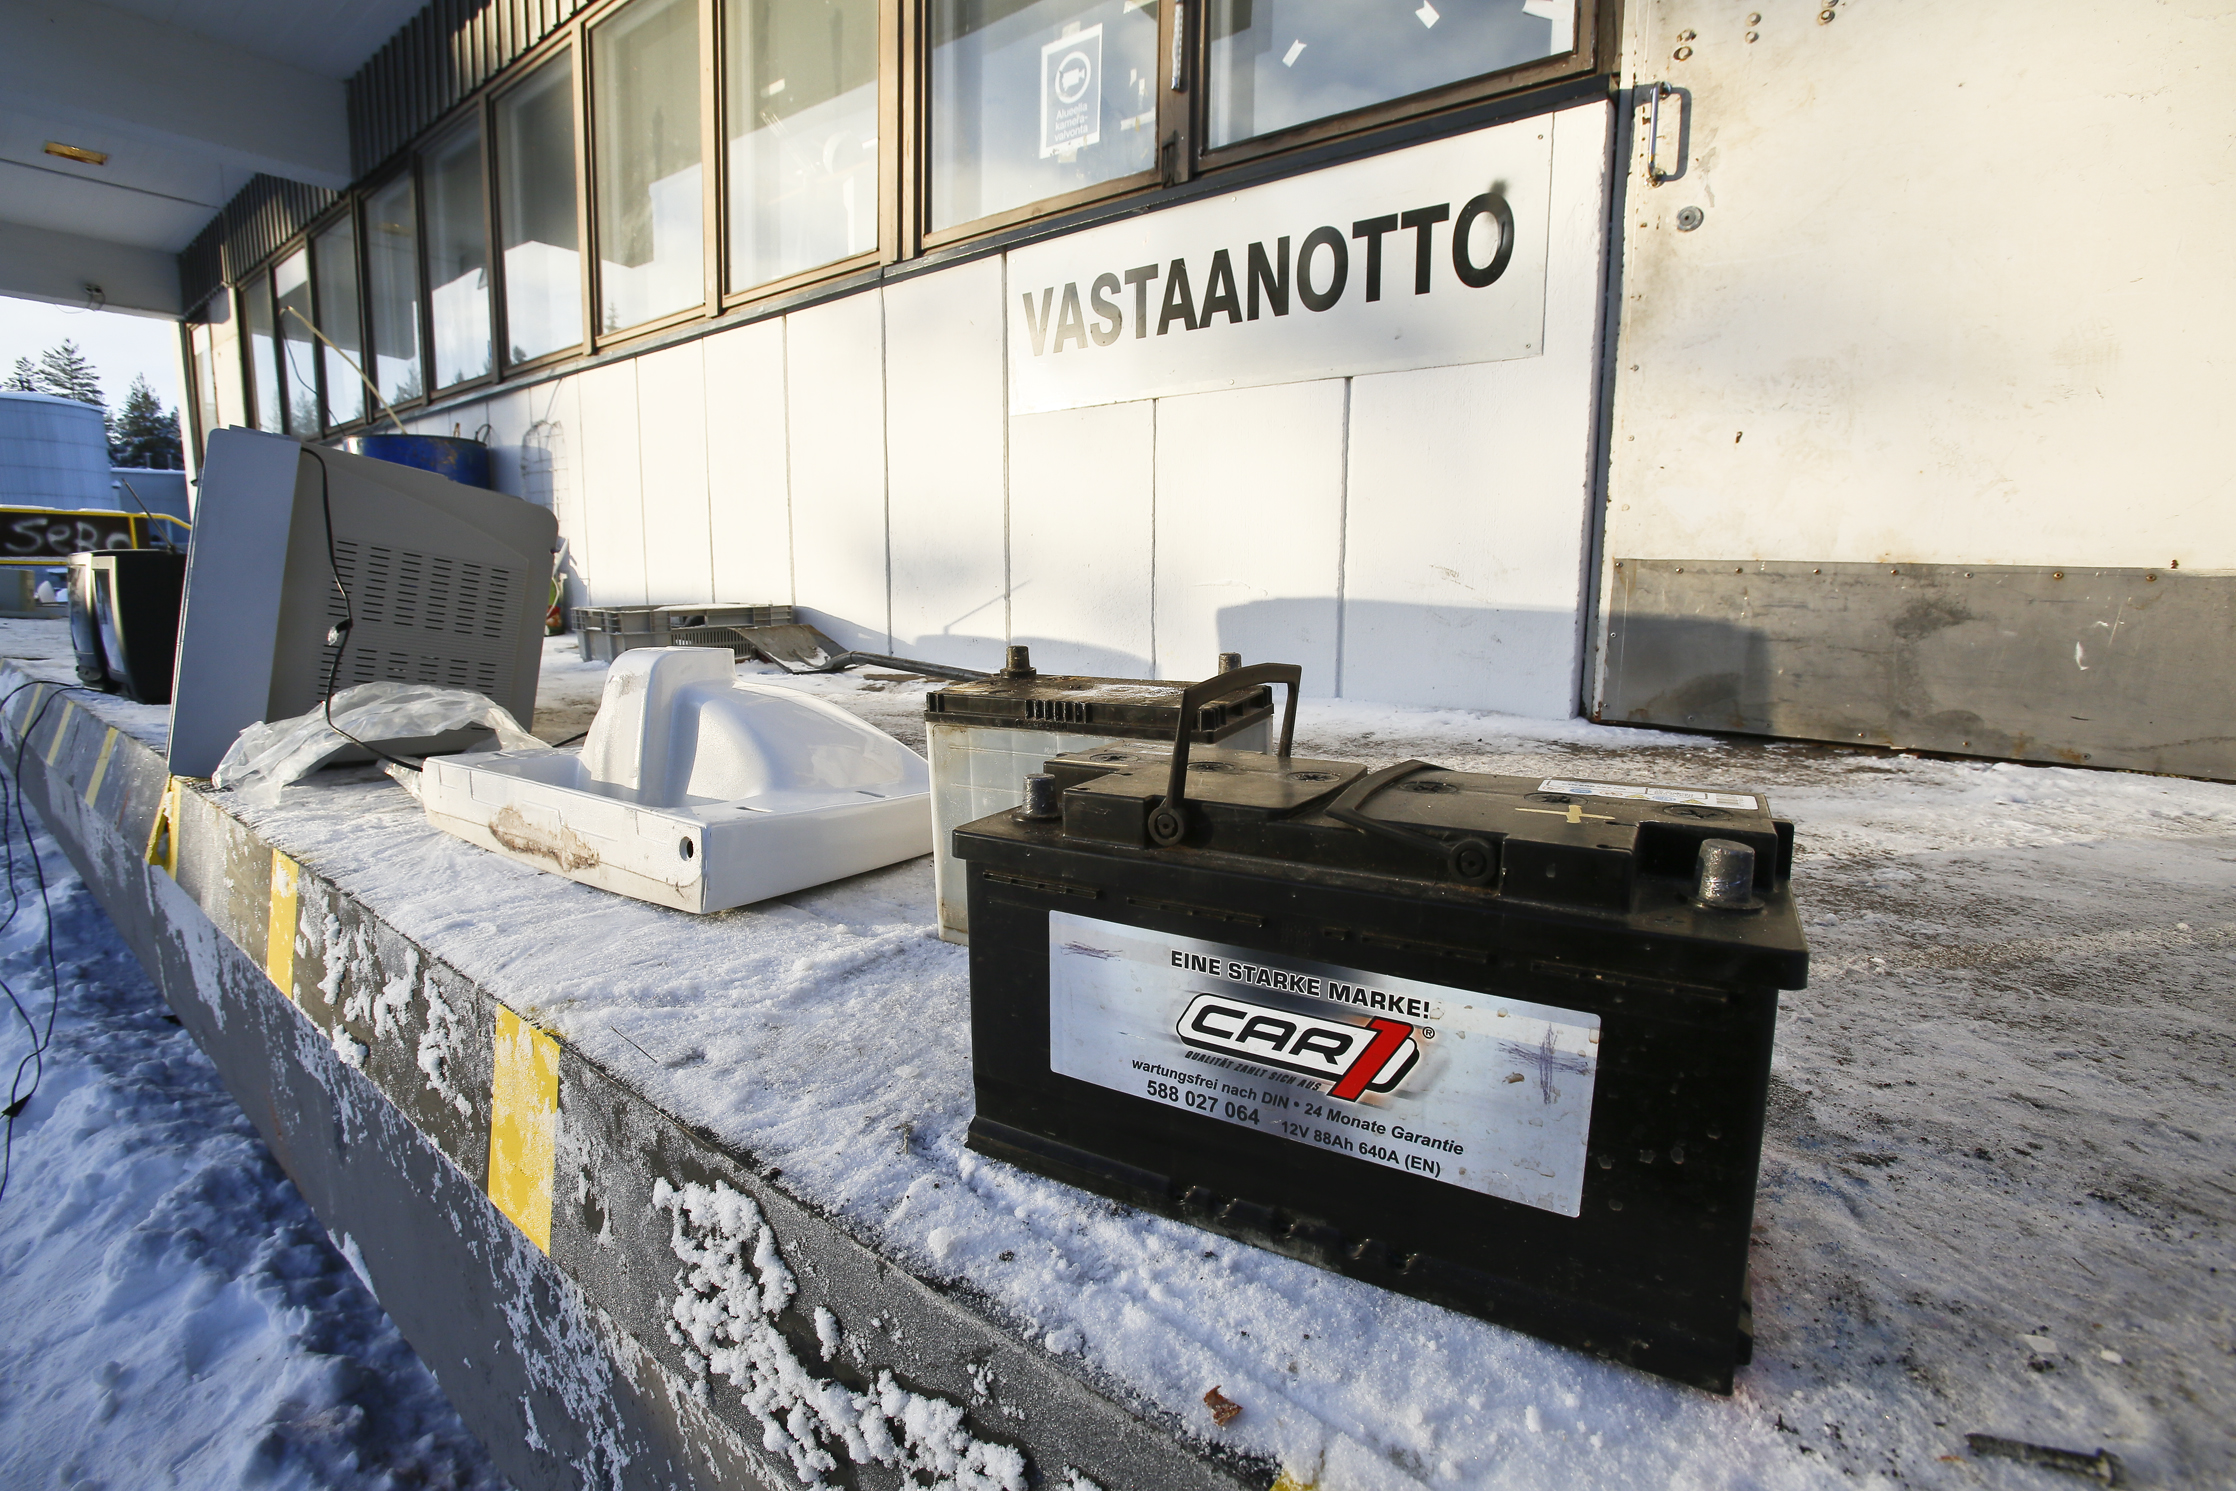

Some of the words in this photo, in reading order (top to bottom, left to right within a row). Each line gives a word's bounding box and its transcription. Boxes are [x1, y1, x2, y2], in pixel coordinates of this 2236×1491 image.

[1054, 124, 1088, 142] valvonta
[1055, 114, 1089, 131] kamera-
[1056, 102, 1088, 120] Alueella
[1022, 192, 1515, 357] VASTAANOTTO
[1171, 949, 1221, 976] EINE
[1228, 962, 1320, 997] STARKE
[1328, 982, 1430, 1020] MARKE!
[1184, 1050, 1234, 1069] QUALITÄT
[1234, 1063, 1267, 1078] ZAHLT
[1268, 1071, 1297, 1086] SICH
[1297, 1078, 1322, 1091] AUS
[1191, 1004, 1414, 1102] CAR1
[1132, 1059, 1218, 1090] wartungsfrei
[1221, 1082, 1257, 1101] nach
[1261, 1091, 1290, 1109] DIN
[1304, 1103, 1322, 1118] 24
[1326, 1108, 1386, 1134] Monate
[1391, 1125, 1464, 1156] Garantie
[1147, 1079, 1179, 1103] 588
[1185, 1090, 1218, 1113] 027
[1224, 1101, 1260, 1125] 064
[1281, 1121, 1310, 1139] 12V
[1313, 1129, 1354, 1152] 88Ah
[1358, 1142, 1400, 1165] 640A
[1404, 1154, 1441, 1178] (EN)
